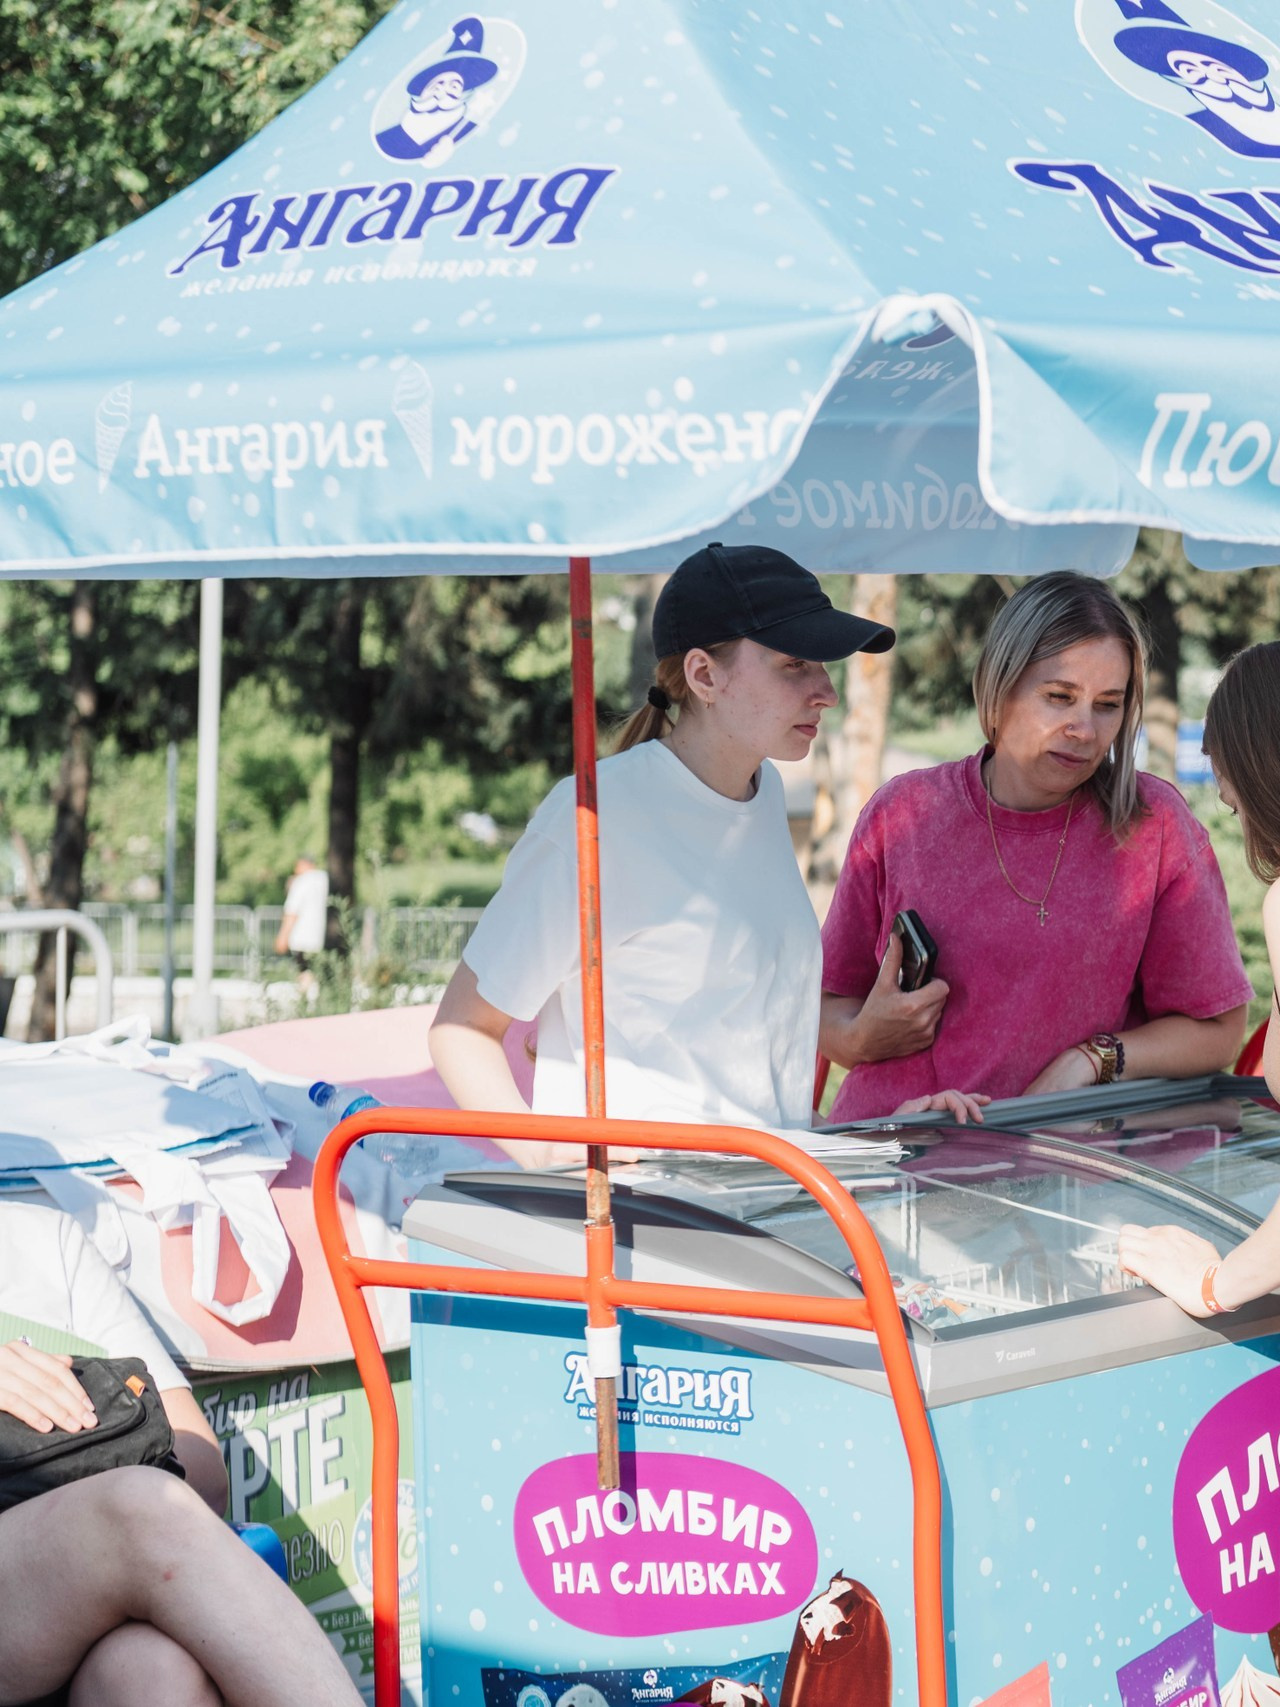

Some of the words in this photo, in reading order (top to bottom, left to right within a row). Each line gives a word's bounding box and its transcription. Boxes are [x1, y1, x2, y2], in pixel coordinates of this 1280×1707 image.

[133, 413, 389, 489] Ангария
[267, 1372, 310, 1418] на
[645, 1412, 739, 1434] исполняются
[220, 1394, 347, 1523] РТЕ
[531, 1488, 793, 1556] ПЛОМБИР
[552, 1562, 601, 1594] НА
[610, 1561, 786, 1596] СЛИВКАХ
[1219, 1531, 1276, 1595] НА
